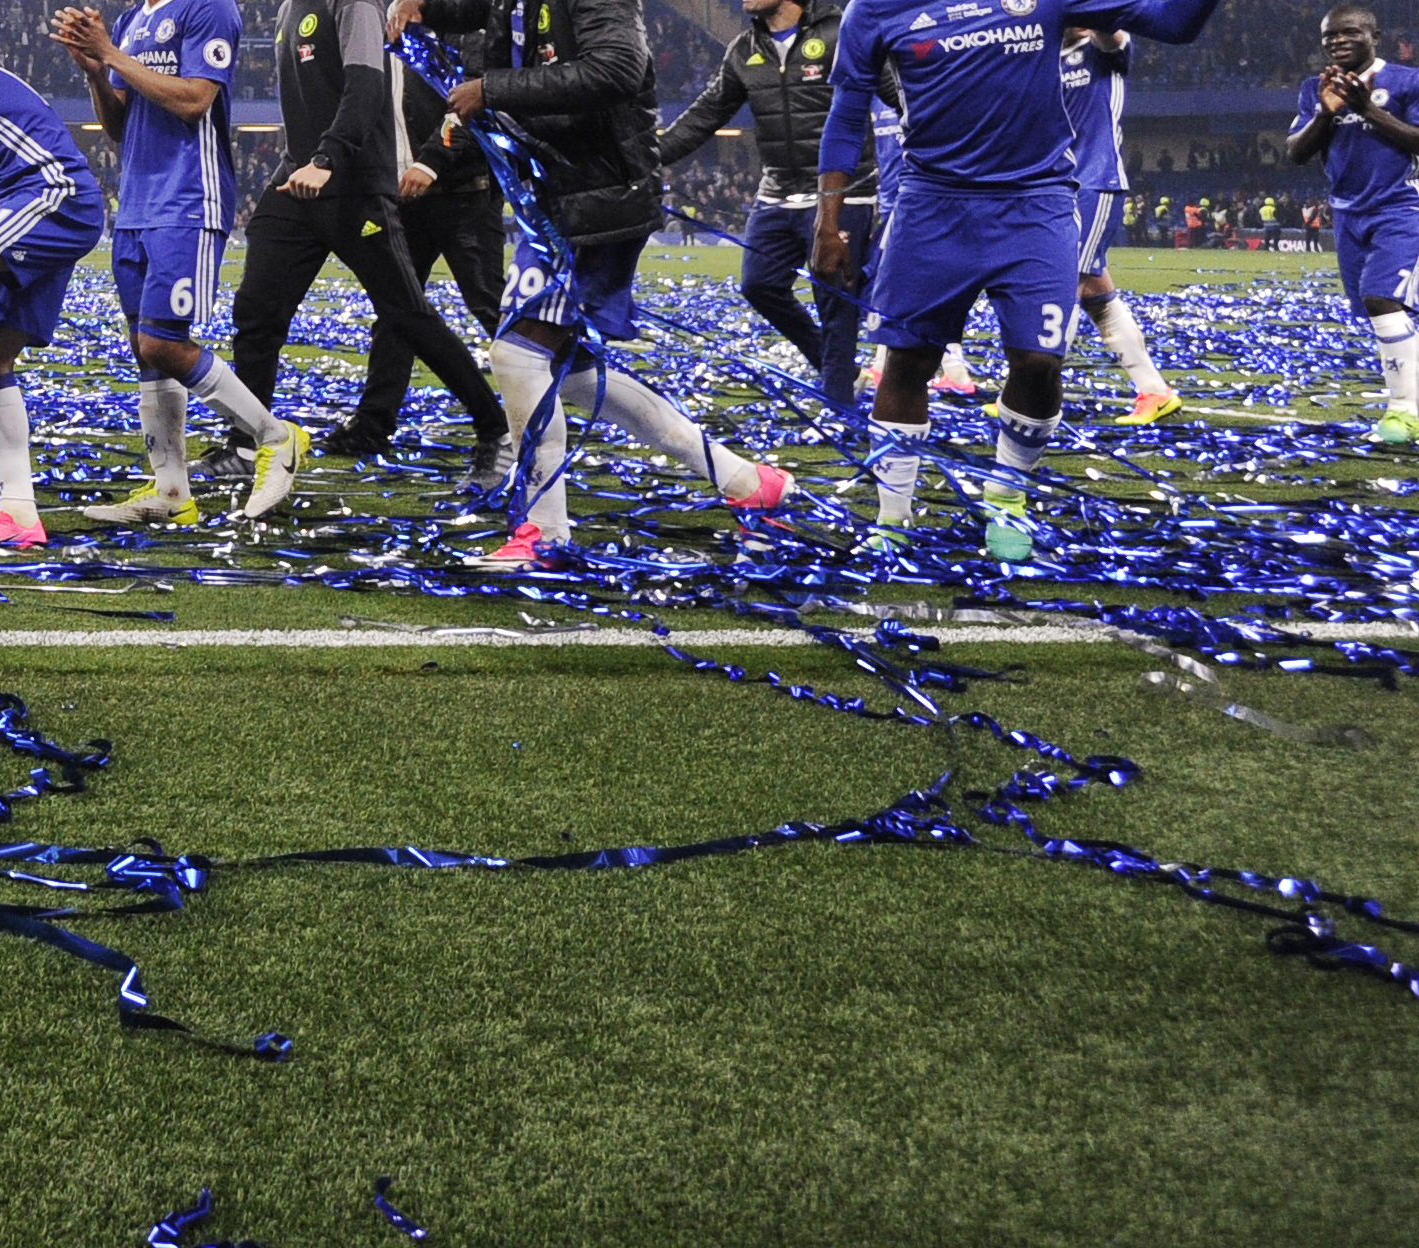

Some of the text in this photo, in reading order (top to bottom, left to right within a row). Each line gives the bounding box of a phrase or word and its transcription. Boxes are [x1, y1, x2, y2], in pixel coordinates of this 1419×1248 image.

[938, 23, 1044, 53] YOKOHAMA
[1003, 39, 1044, 55] TYRES
[169, 277, 194, 316] 6
[500, 263, 545, 309] 29
